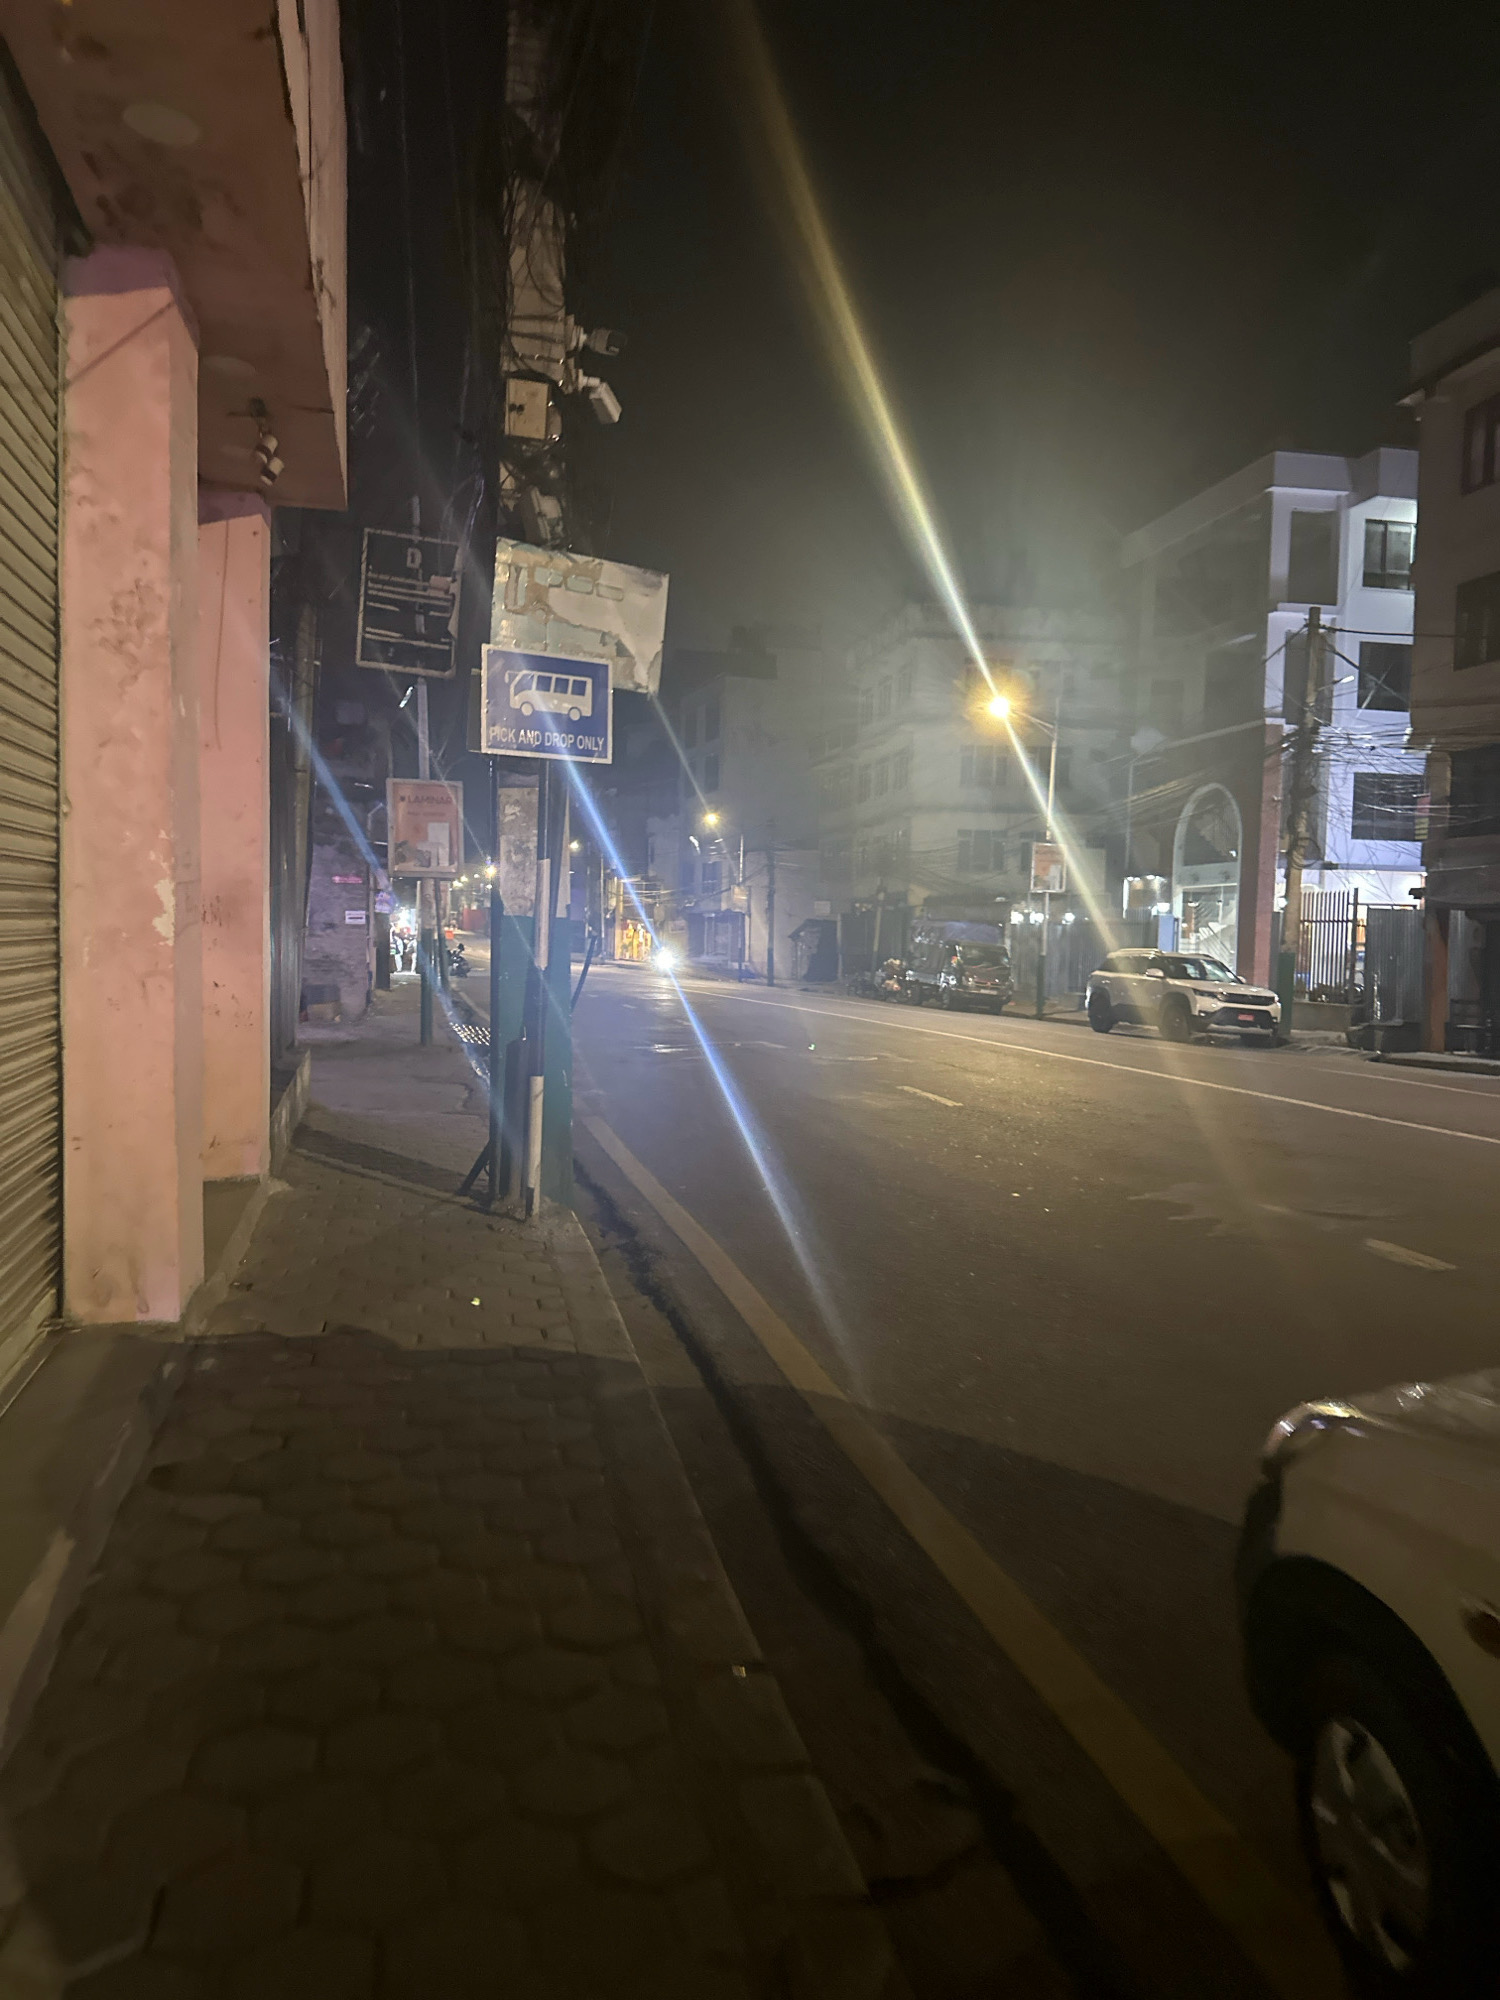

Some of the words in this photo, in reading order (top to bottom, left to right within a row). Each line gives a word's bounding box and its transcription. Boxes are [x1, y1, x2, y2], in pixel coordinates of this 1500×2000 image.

[489, 727, 516, 742] PICK
[519, 729, 542, 745] AND
[545, 731, 574, 748] DROP
[576, 735, 604, 751] ONLY
